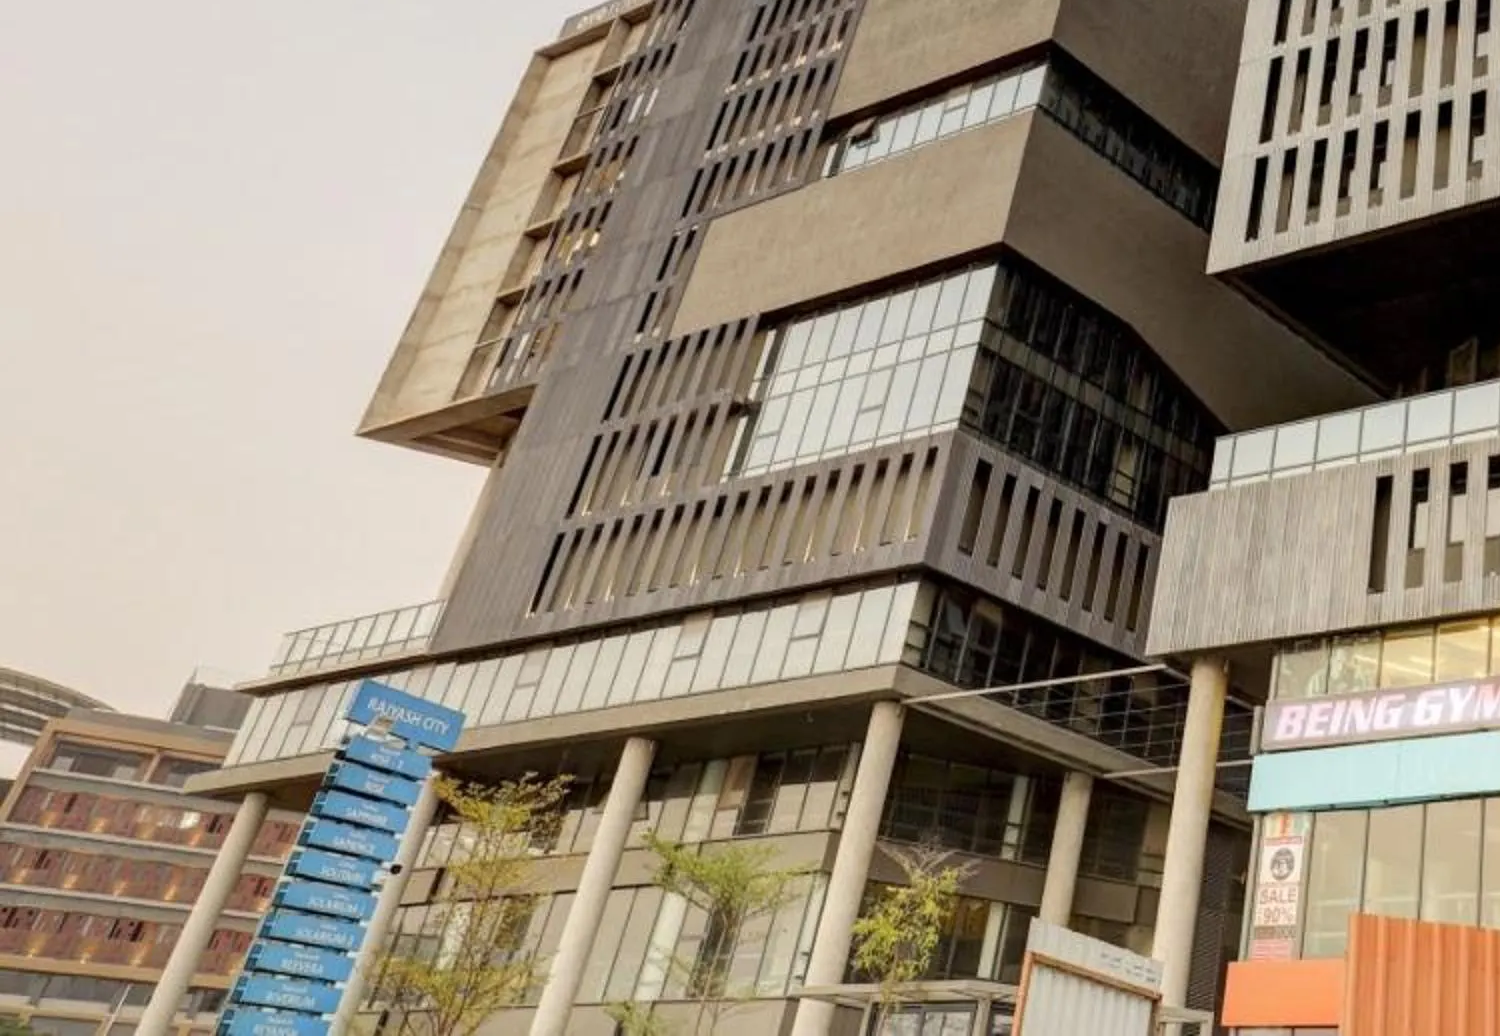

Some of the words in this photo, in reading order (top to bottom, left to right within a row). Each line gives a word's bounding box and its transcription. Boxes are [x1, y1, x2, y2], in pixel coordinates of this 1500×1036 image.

[422, 716, 450, 734] CITY
[1272, 693, 1405, 742] BEING
[1259, 887, 1297, 905] SALE
